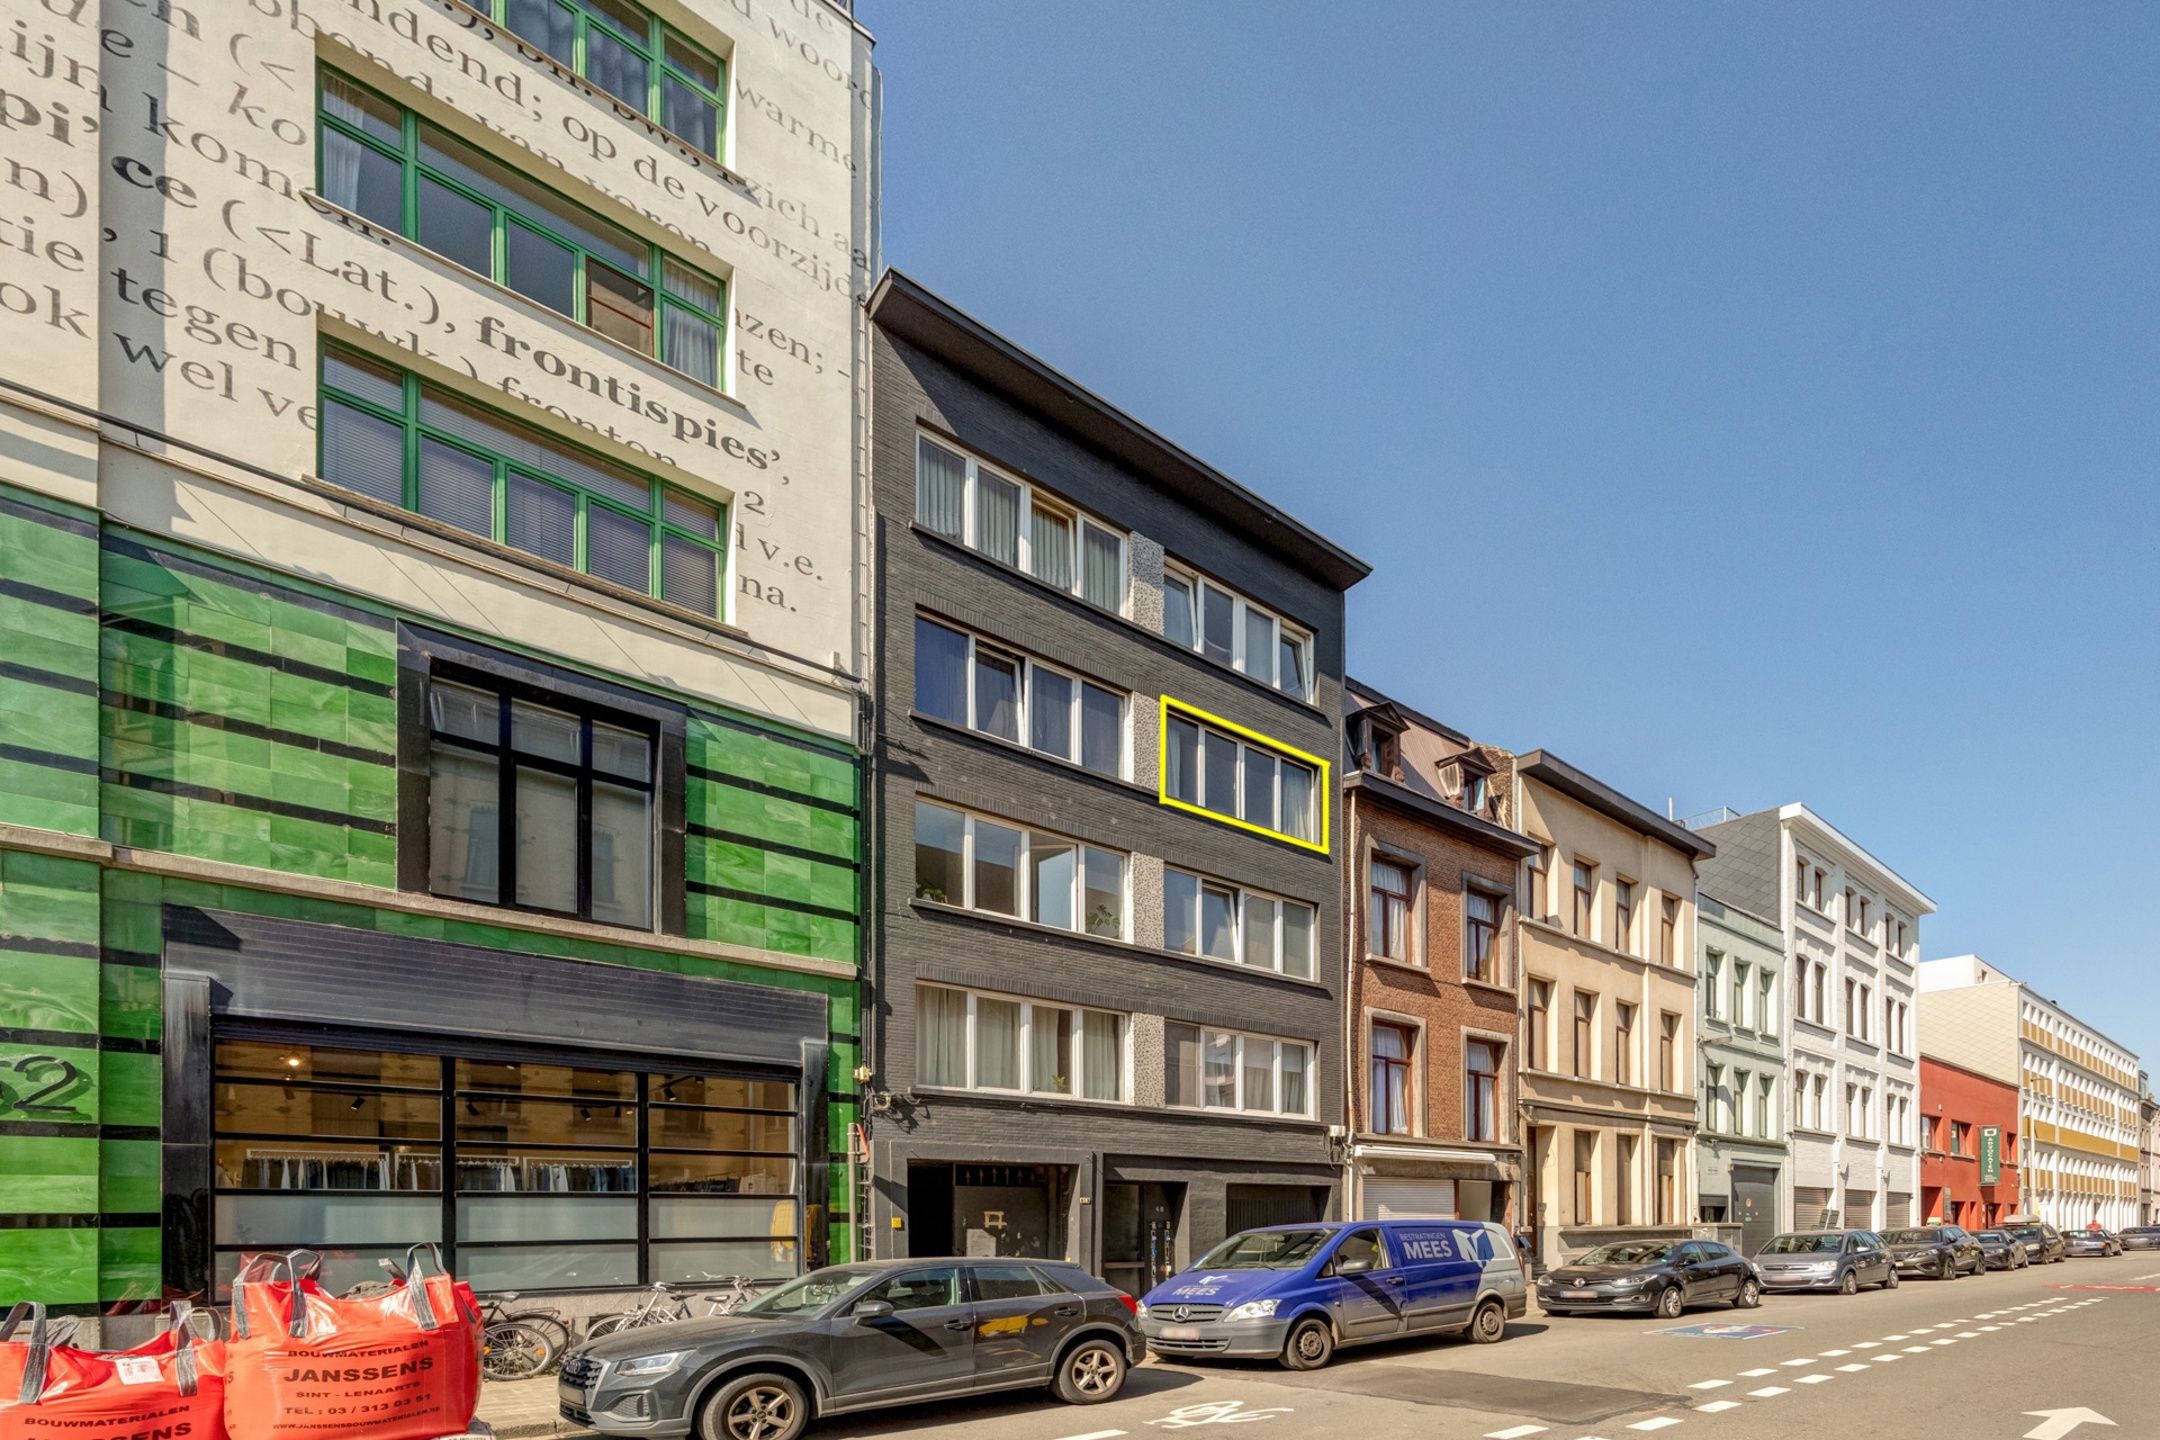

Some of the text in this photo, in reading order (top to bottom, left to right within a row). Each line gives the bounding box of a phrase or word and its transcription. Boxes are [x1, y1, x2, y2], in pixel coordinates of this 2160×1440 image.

[563, 115, 617, 163] op
[633, 155, 685, 200] de
[110, 267, 302, 371] tegen
[758, 538, 823, 581] v.e.
[0, 282, 92, 341] ok
[112, 332, 239, 403] wel
[739, 574, 797, 613] na.
[744, 490, 766, 516] 2
[1402, 1239, 1453, 1260] MEES
[288, 1340, 430, 1358] BOUWMATERIALEN
[284, 1357, 434, 1383] JANSSENS
[344, 1381, 421, 1398] LENAARTS
[24, 1405, 191, 1428] BOUWMATERIALEN
[285, 1406, 314, 1415] TEL
[327, 1406, 347, 1415] 03
[361, 1403, 389, 1414] 313
